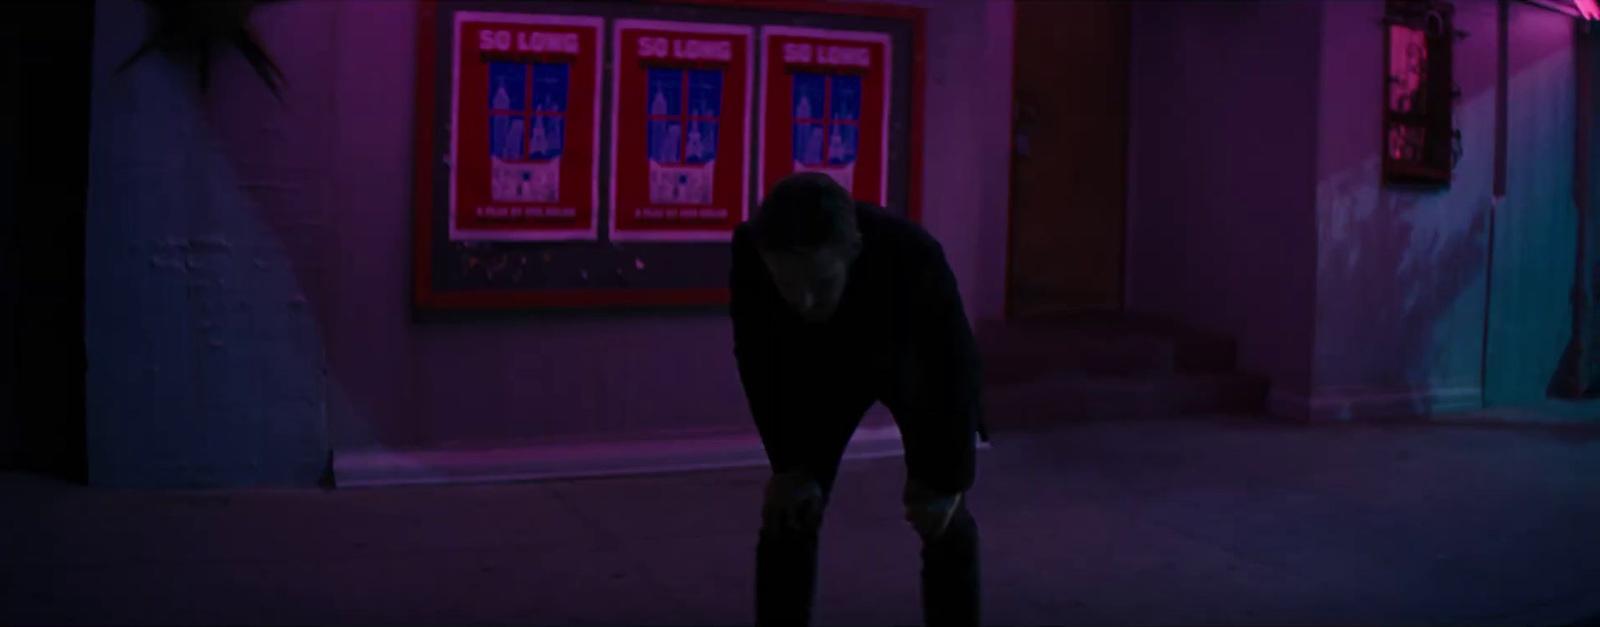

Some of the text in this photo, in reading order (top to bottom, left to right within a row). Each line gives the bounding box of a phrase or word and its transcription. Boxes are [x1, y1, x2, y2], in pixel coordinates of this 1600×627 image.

[479, 29, 579, 53] SO LONG
[637, 36, 731, 61] SO LONG
[783, 42, 870, 67] SO LONG
